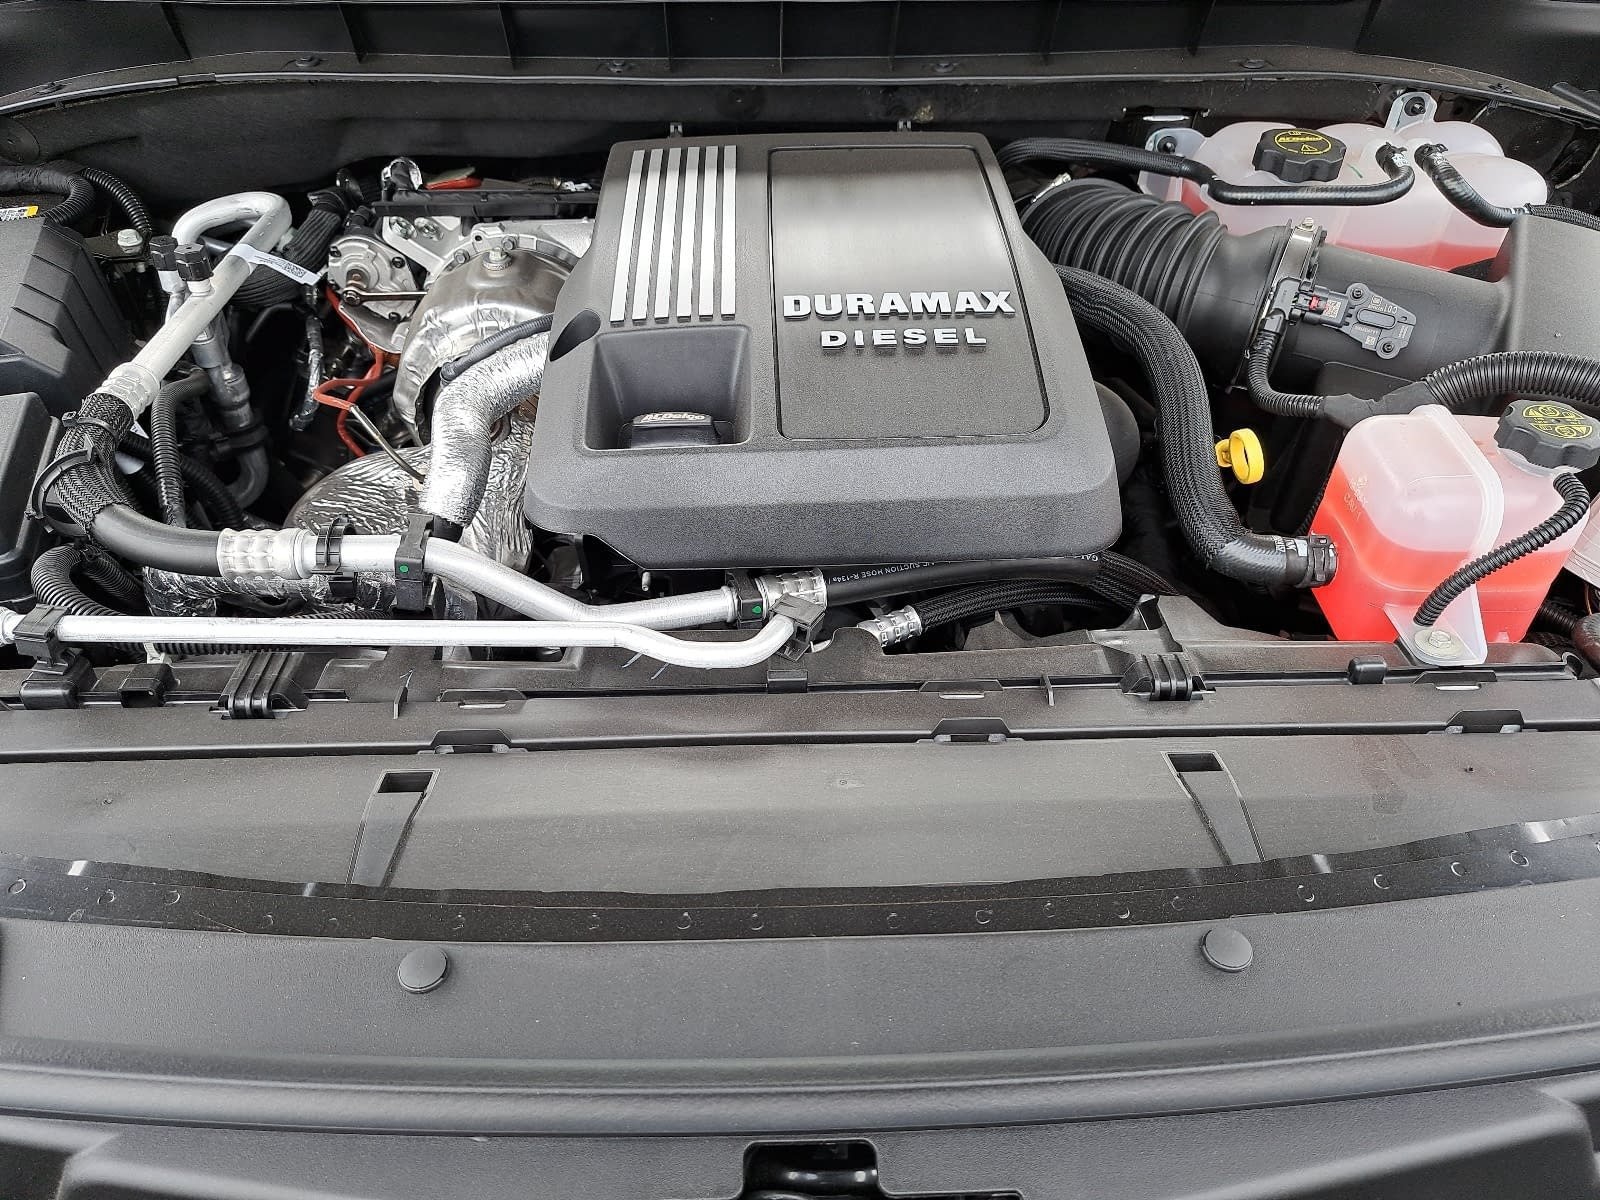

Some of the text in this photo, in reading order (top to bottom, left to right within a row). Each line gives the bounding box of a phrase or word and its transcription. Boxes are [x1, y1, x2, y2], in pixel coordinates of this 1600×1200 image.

[783, 291, 1016, 319] DURAMAX
[820, 327, 987, 348] DIESEL
[639, 412, 706, 424] ACDelco
[860, 569, 883, 579] HOSE
[884, 562, 921, 574] SUCTION
[832, 572, 859, 583] R-134a
